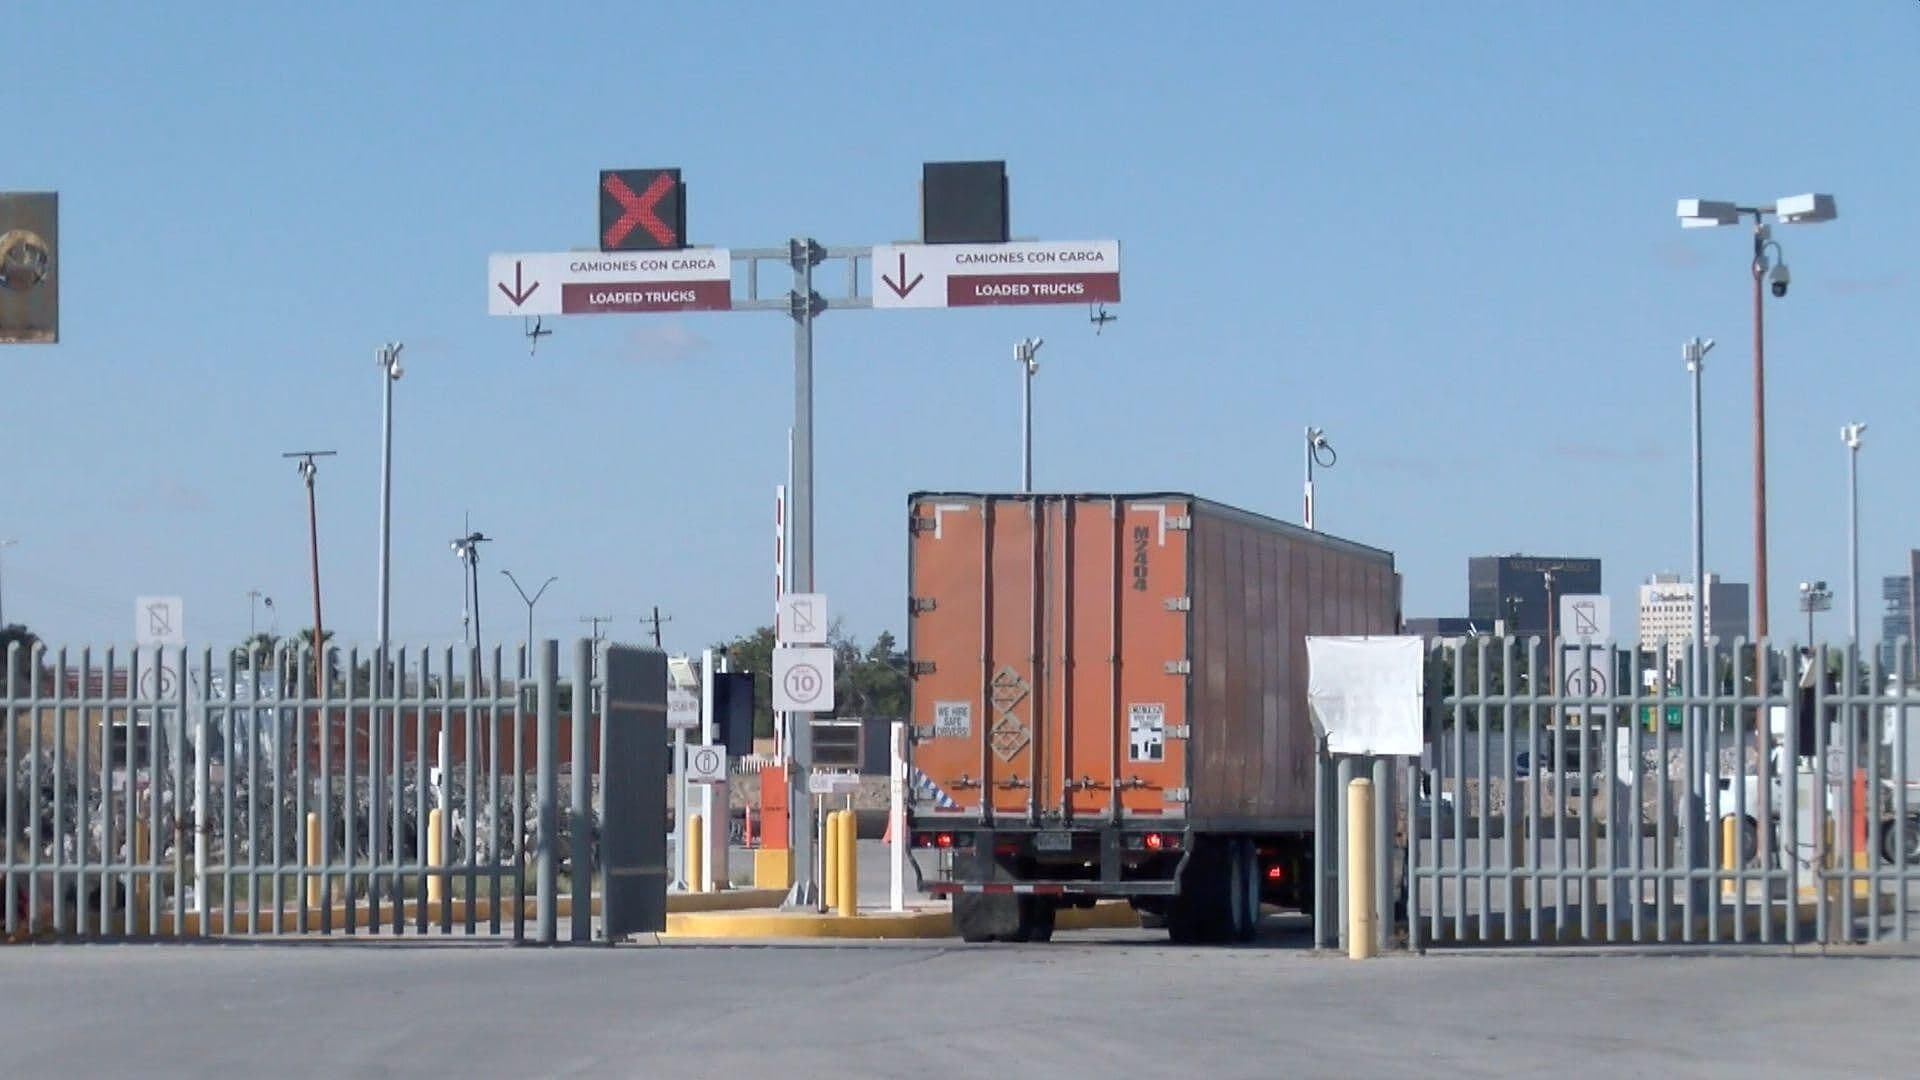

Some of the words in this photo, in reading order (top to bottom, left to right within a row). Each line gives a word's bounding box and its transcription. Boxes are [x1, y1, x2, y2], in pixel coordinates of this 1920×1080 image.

[955, 252, 1024, 265] CAMIONES
[1027, 252, 1056, 263] CON
[1059, 250, 1104, 262] CARGA
[570, 260, 637, 273] CAMIONES
[640, 260, 668, 271] CON
[671, 258, 716, 270] CARGA
[975, 283, 1030, 297] LOADED
[1032, 282, 1084, 295] TRUCKS
[589, 291, 643, 305] LOADED
[645, 290, 697, 303] TRUCKS
[791, 675, 814, 692] 10
[938, 706, 950, 717] WE
[943, 717, 963, 727] SAFE
